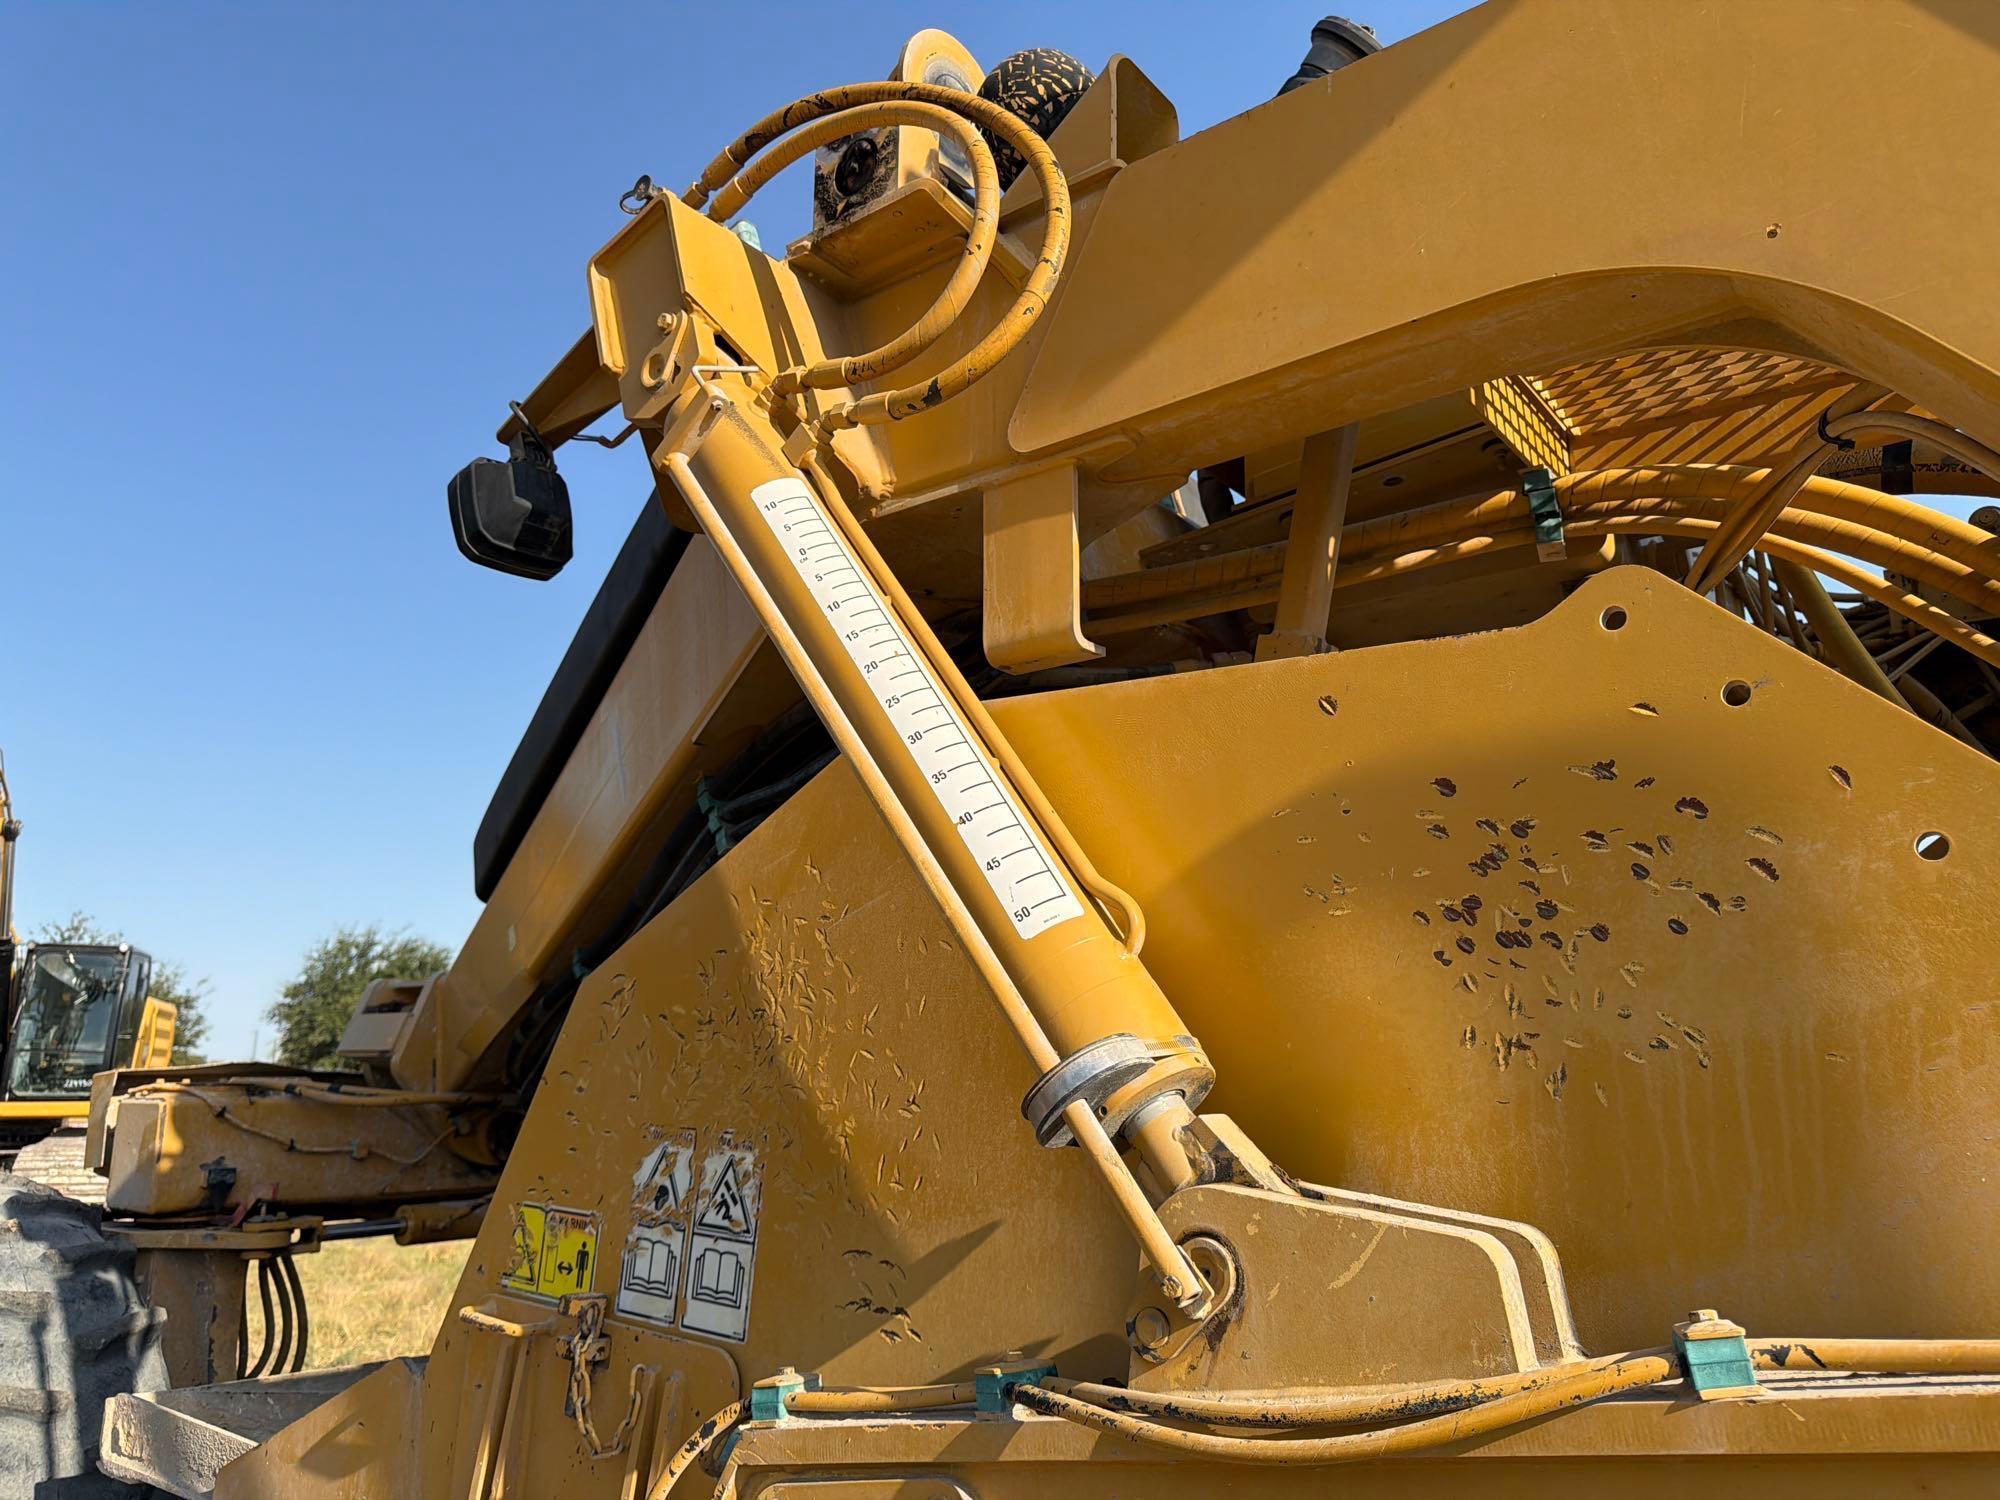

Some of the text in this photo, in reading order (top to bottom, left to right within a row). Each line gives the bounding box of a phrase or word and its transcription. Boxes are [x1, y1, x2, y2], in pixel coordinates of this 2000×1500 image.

[764, 501, 777, 512] 10
[783, 523, 792, 532] 5
[798, 547, 807, 556] 0
[814, 573, 824, 582] 5
[826, 600, 841, 612] 10
[845, 630, 859, 642] 15
[863, 660, 879, 674] 20
[885, 694, 901, 709] 25
[907, 730, 923, 745] 30
[931, 769, 947, 784] 35
[957, 811, 974, 826] 40
[986, 856, 1001, 872] 45
[1013, 906, 1031, 923] 50
